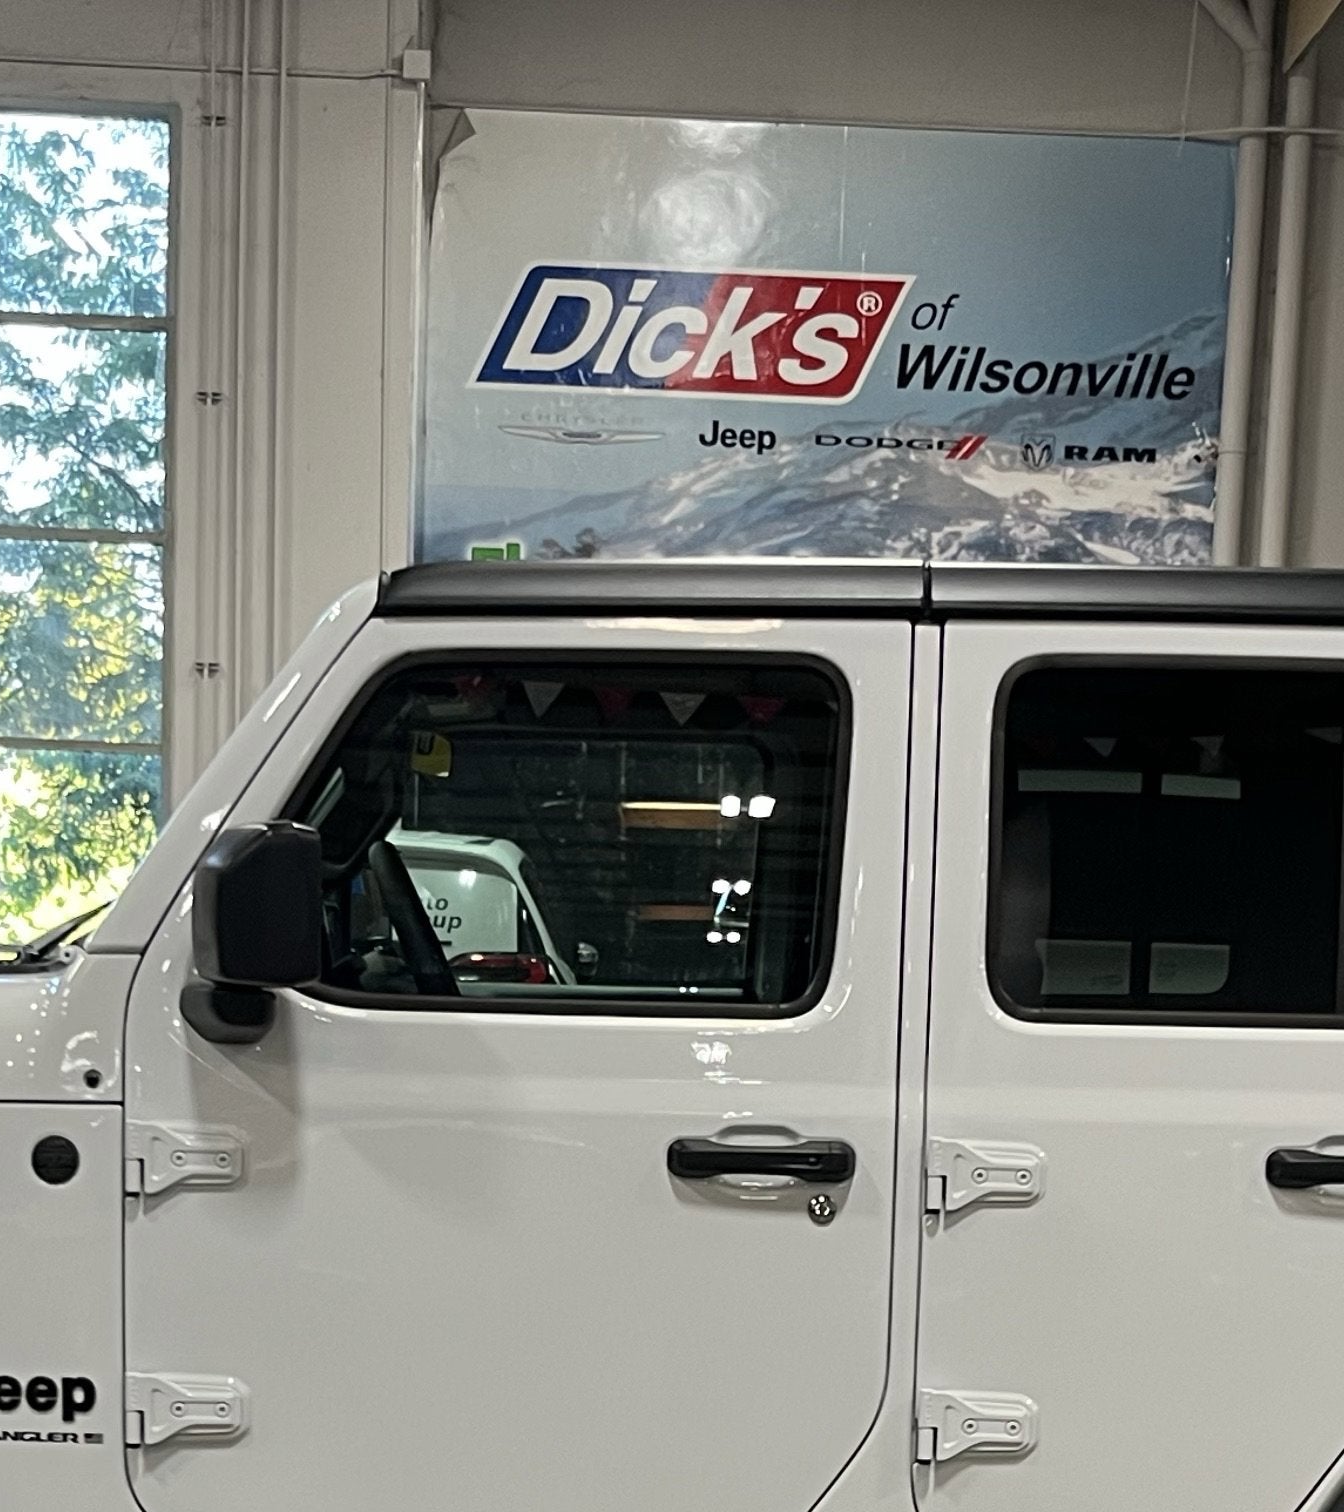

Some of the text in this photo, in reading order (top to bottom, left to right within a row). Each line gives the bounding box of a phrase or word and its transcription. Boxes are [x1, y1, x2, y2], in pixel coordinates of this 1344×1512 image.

[911, 294, 960, 331] of
[896, 343, 1196, 400] Wilsonville
[698, 420, 777, 454] Jeep
[814, 434, 960, 451] DODGE
[1064, 445, 1157, 464] RAM
